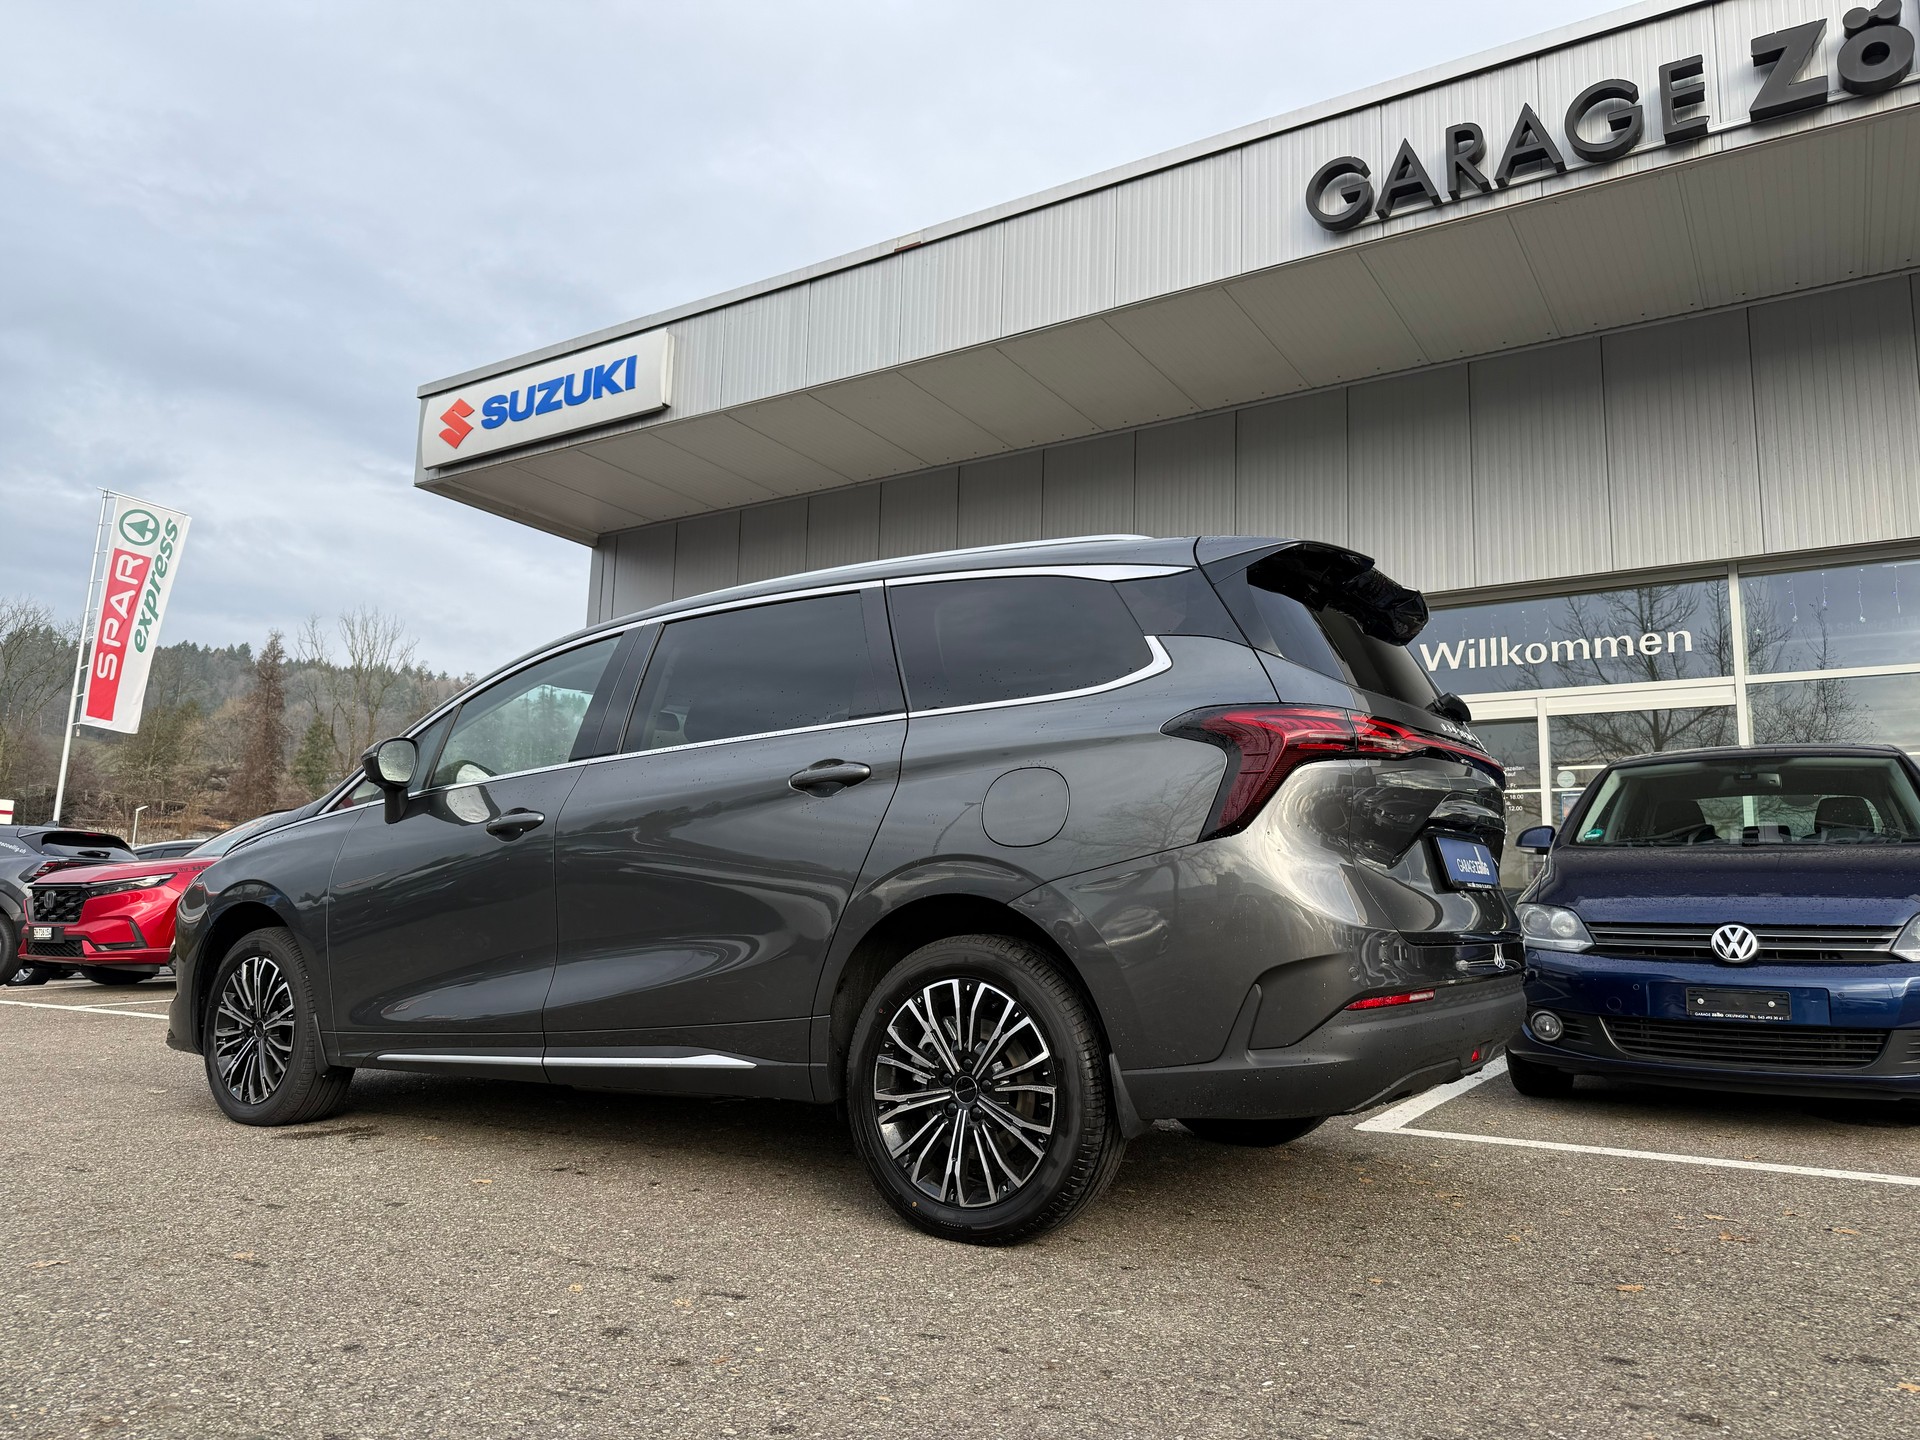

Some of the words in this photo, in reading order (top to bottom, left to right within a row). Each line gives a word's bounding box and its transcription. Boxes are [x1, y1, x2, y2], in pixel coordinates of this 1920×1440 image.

[1305, 54, 1709, 232] GARAGE
[481, 354, 638, 430] SUZUKI
[96, 554, 144, 681] SPAR
[133, 517, 179, 653] express
[1420, 628, 1693, 672] Willkommen
